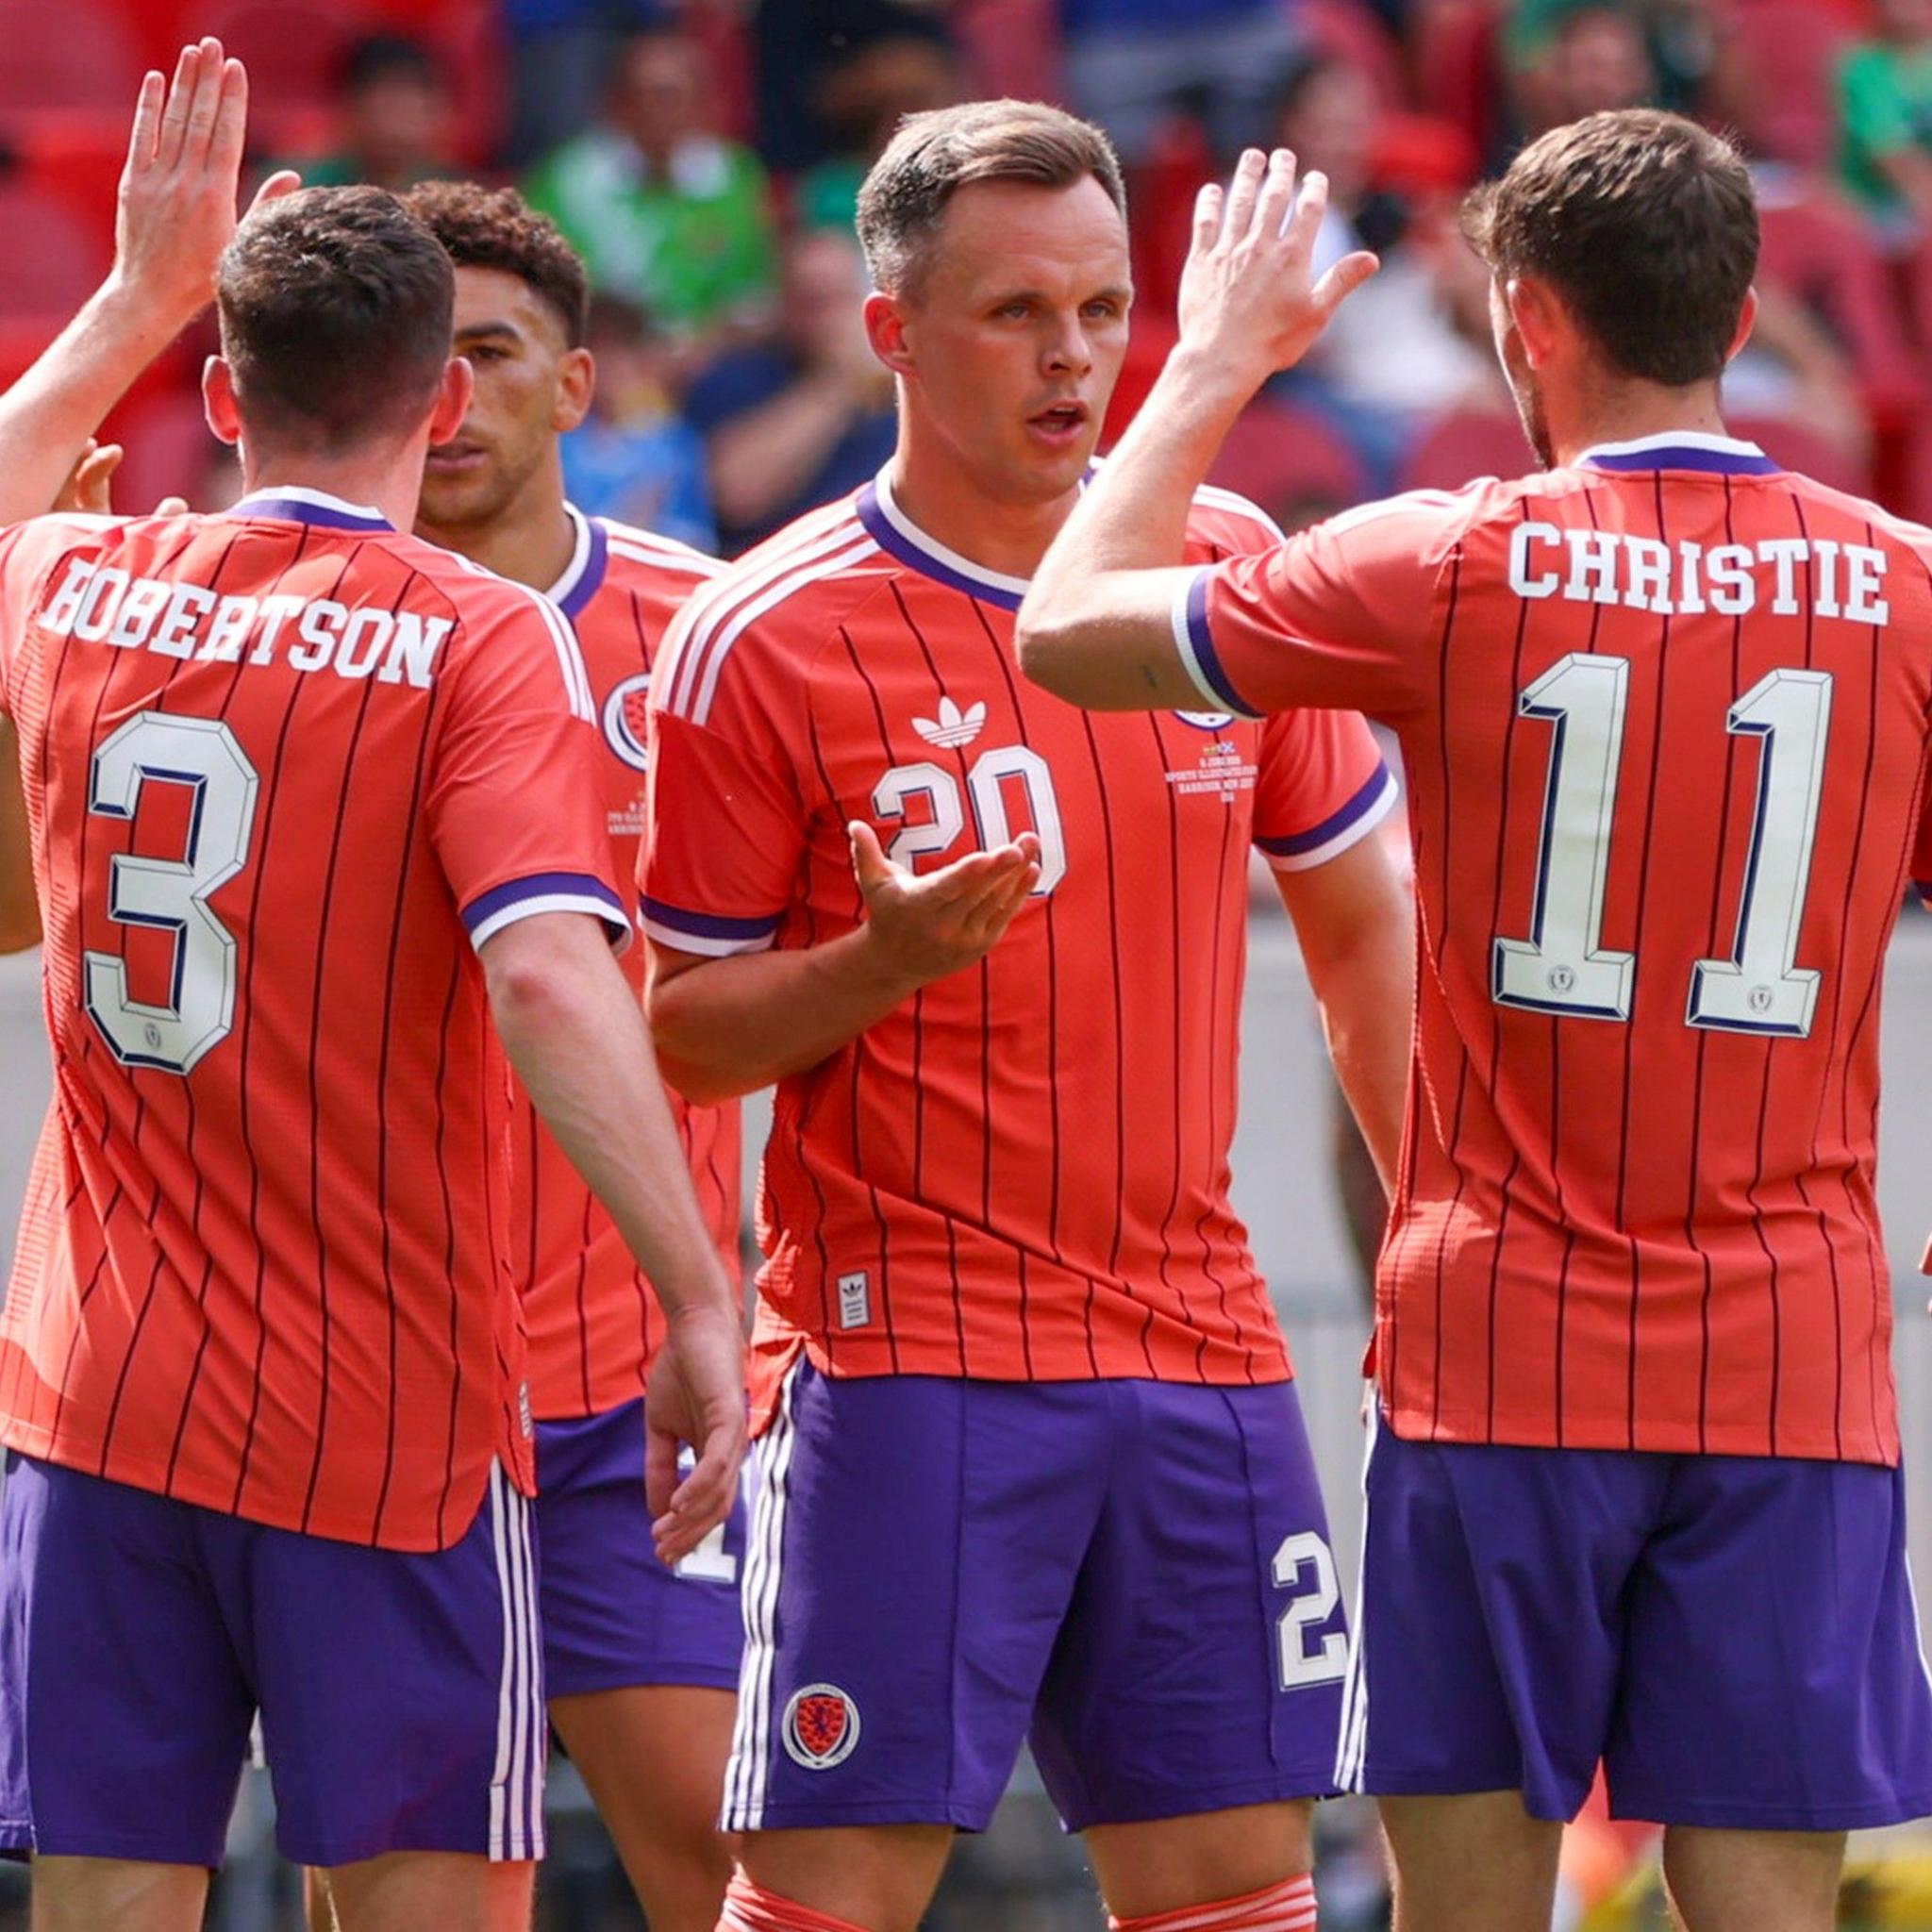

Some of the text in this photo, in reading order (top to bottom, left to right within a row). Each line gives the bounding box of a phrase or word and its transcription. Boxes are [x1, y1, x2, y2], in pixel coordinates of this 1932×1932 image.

[38, 558, 456, 689] ROBERTSON
[1509, 521, 1890, 626] CHRISTIE
[83, 709, 260, 1075] 3
[870, 744, 1067, 898] 20
[1491, 651, 1835, 1039] 11
